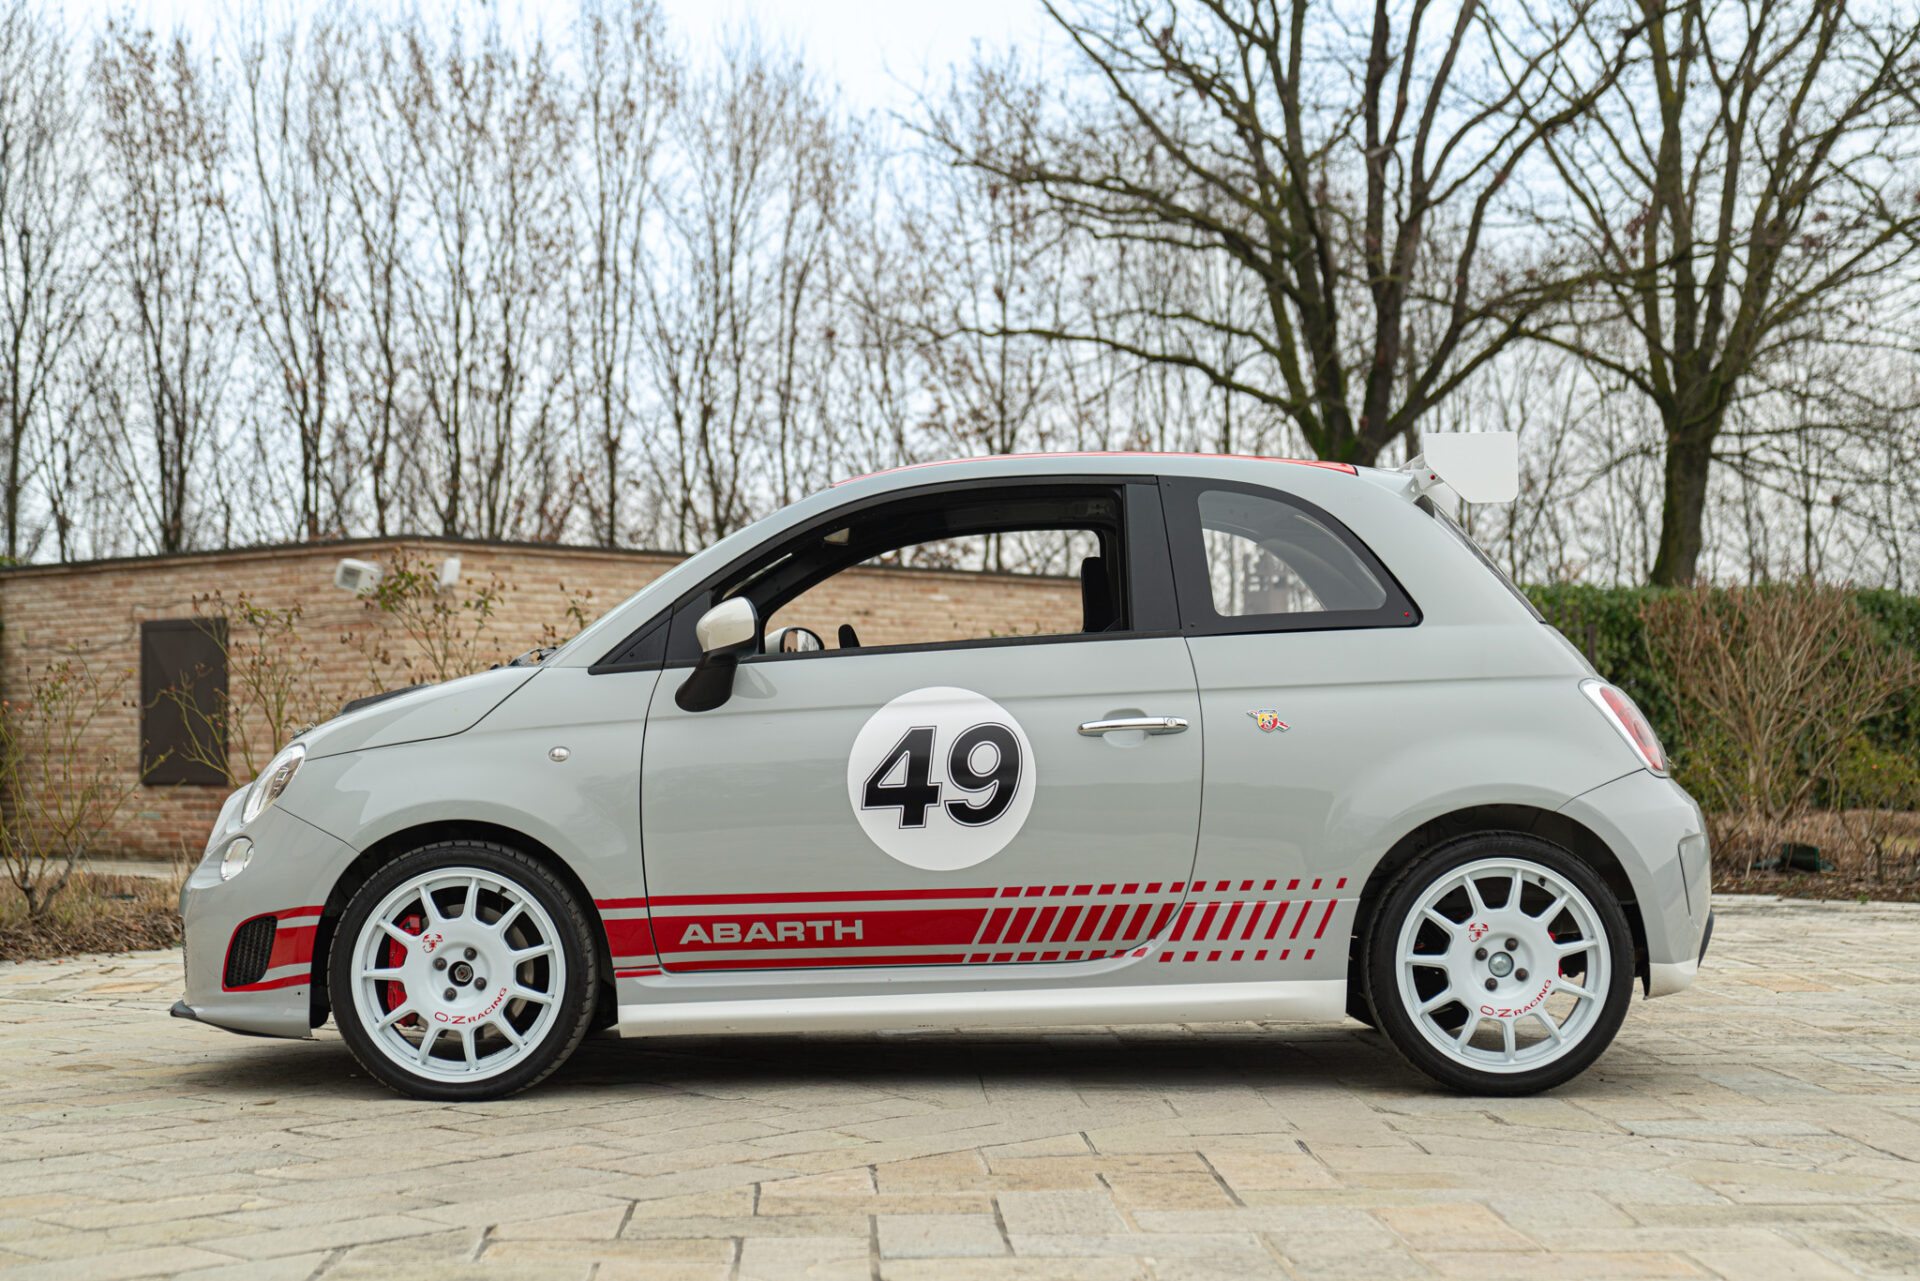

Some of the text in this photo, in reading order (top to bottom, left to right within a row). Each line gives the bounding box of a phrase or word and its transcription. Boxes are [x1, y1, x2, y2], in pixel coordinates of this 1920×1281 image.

[861, 721, 1023, 829] 49
[678, 919, 864, 945] ABARTH
[467, 987, 508, 1023] RACING
[1513, 979, 1552, 1016] RACING
